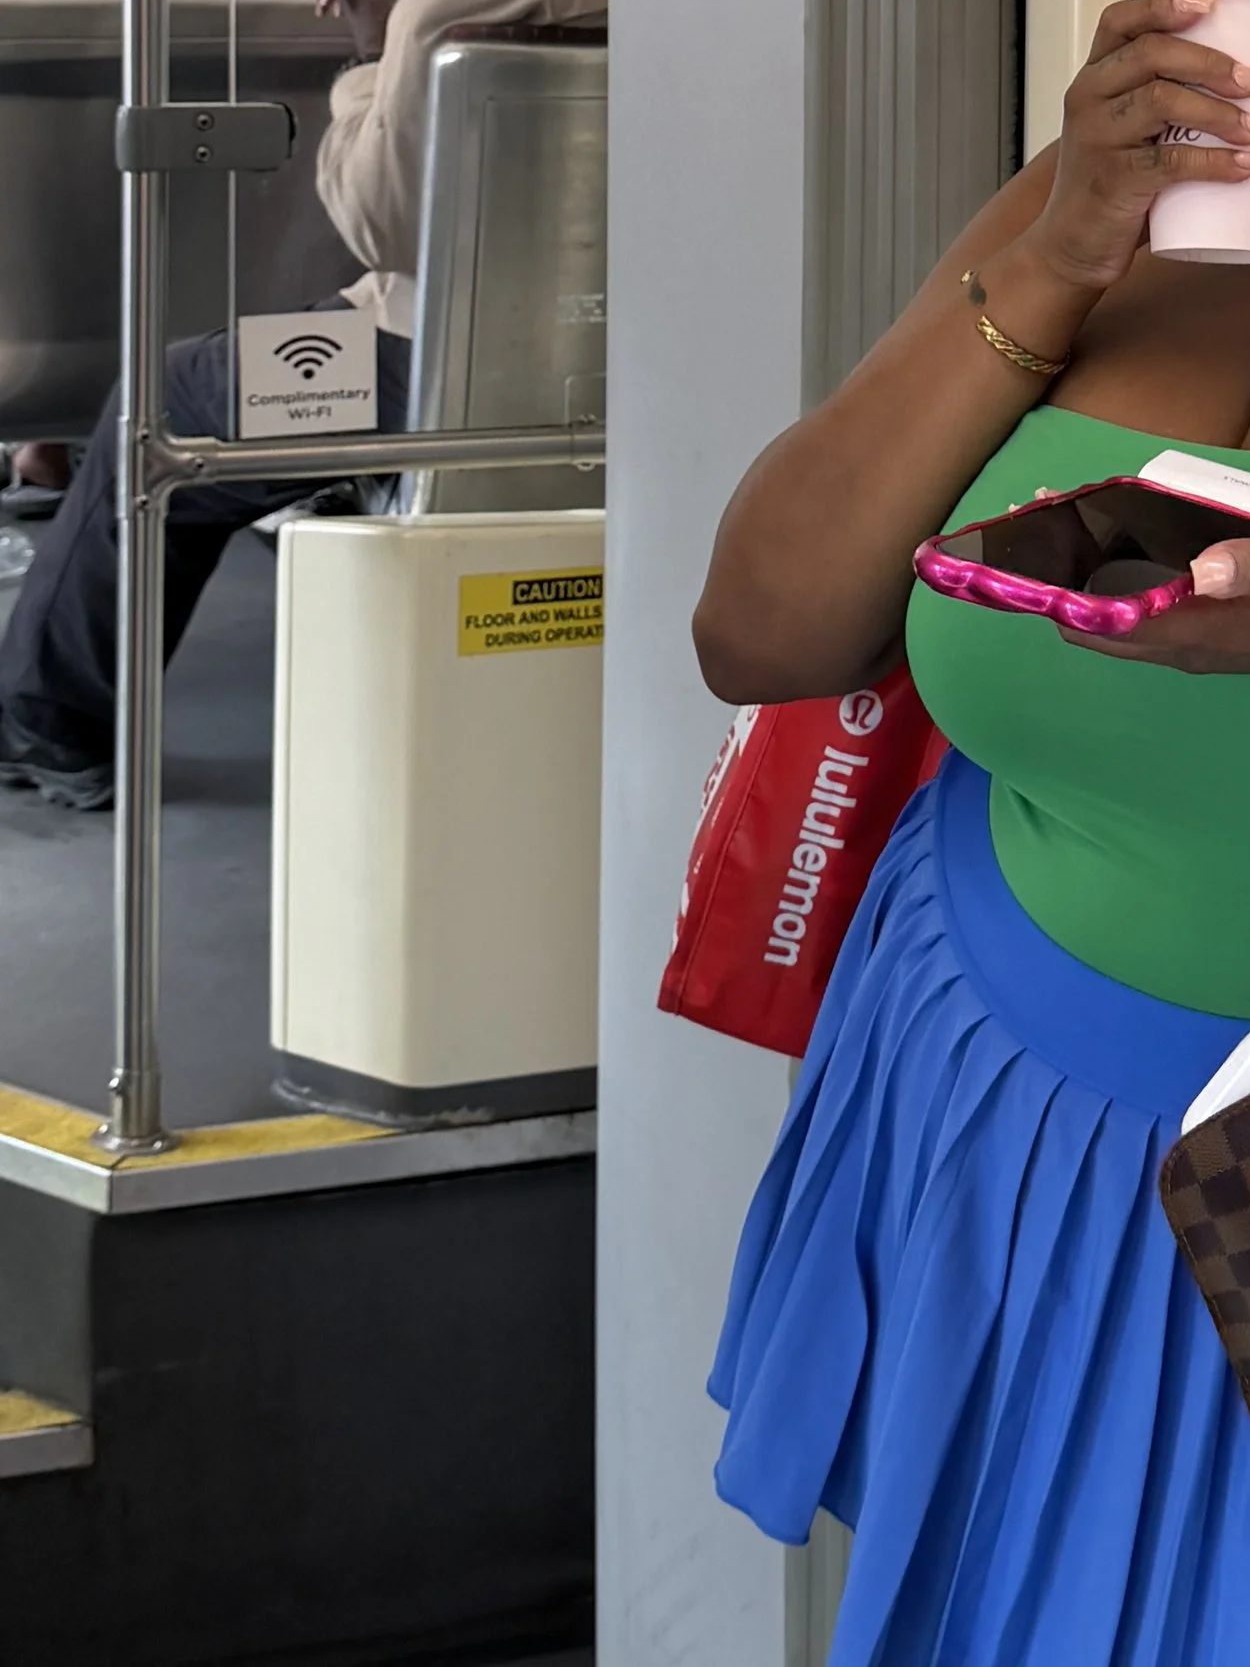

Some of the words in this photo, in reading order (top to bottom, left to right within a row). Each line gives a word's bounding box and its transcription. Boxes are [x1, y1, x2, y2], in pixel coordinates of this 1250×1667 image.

[248, 388, 371, 407] Complimentary
[515, 578, 601, 603] CAUTION
[465, 612, 515, 629] FLOOR
[519, 609, 550, 624] AND
[553, 605, 602, 621] WALLS
[485, 629, 542, 647] DURING
[763, 744, 869, 967] lululemon
